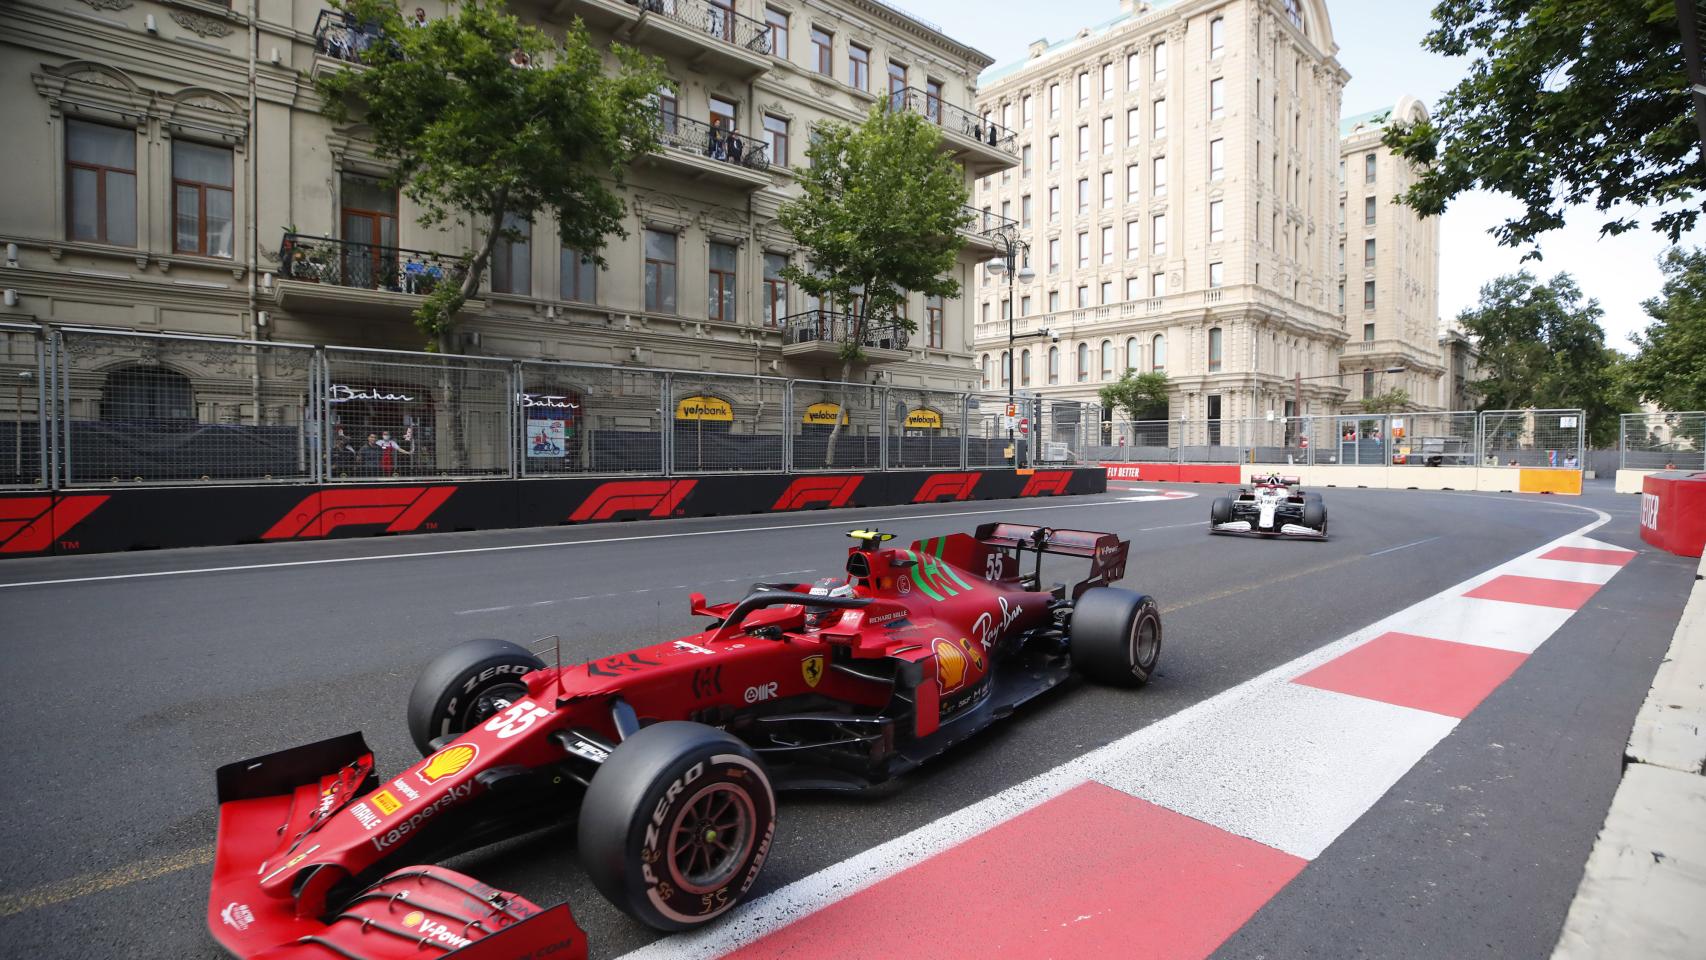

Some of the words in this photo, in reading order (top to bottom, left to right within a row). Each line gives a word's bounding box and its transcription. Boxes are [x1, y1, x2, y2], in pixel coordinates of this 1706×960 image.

[684, 404, 726, 417] yelobank
[1107, 466, 1117, 477] FLY
[1118, 467, 1139, 478] BETTER
[1641, 492, 1659, 530] ETTER
[61, 541, 80, 549] TM
[985, 553, 1003, 580] 55
[972, 596, 1023, 652] Ray-Ban
[463, 664, 529, 694] ZERO
[484, 700, 550, 739] 55
[350, 802, 382, 831] MAHLE
[371, 780, 473, 851] kaspersky
[644, 761, 704, 851] ZERO
[417, 919, 473, 949] V-Powe
